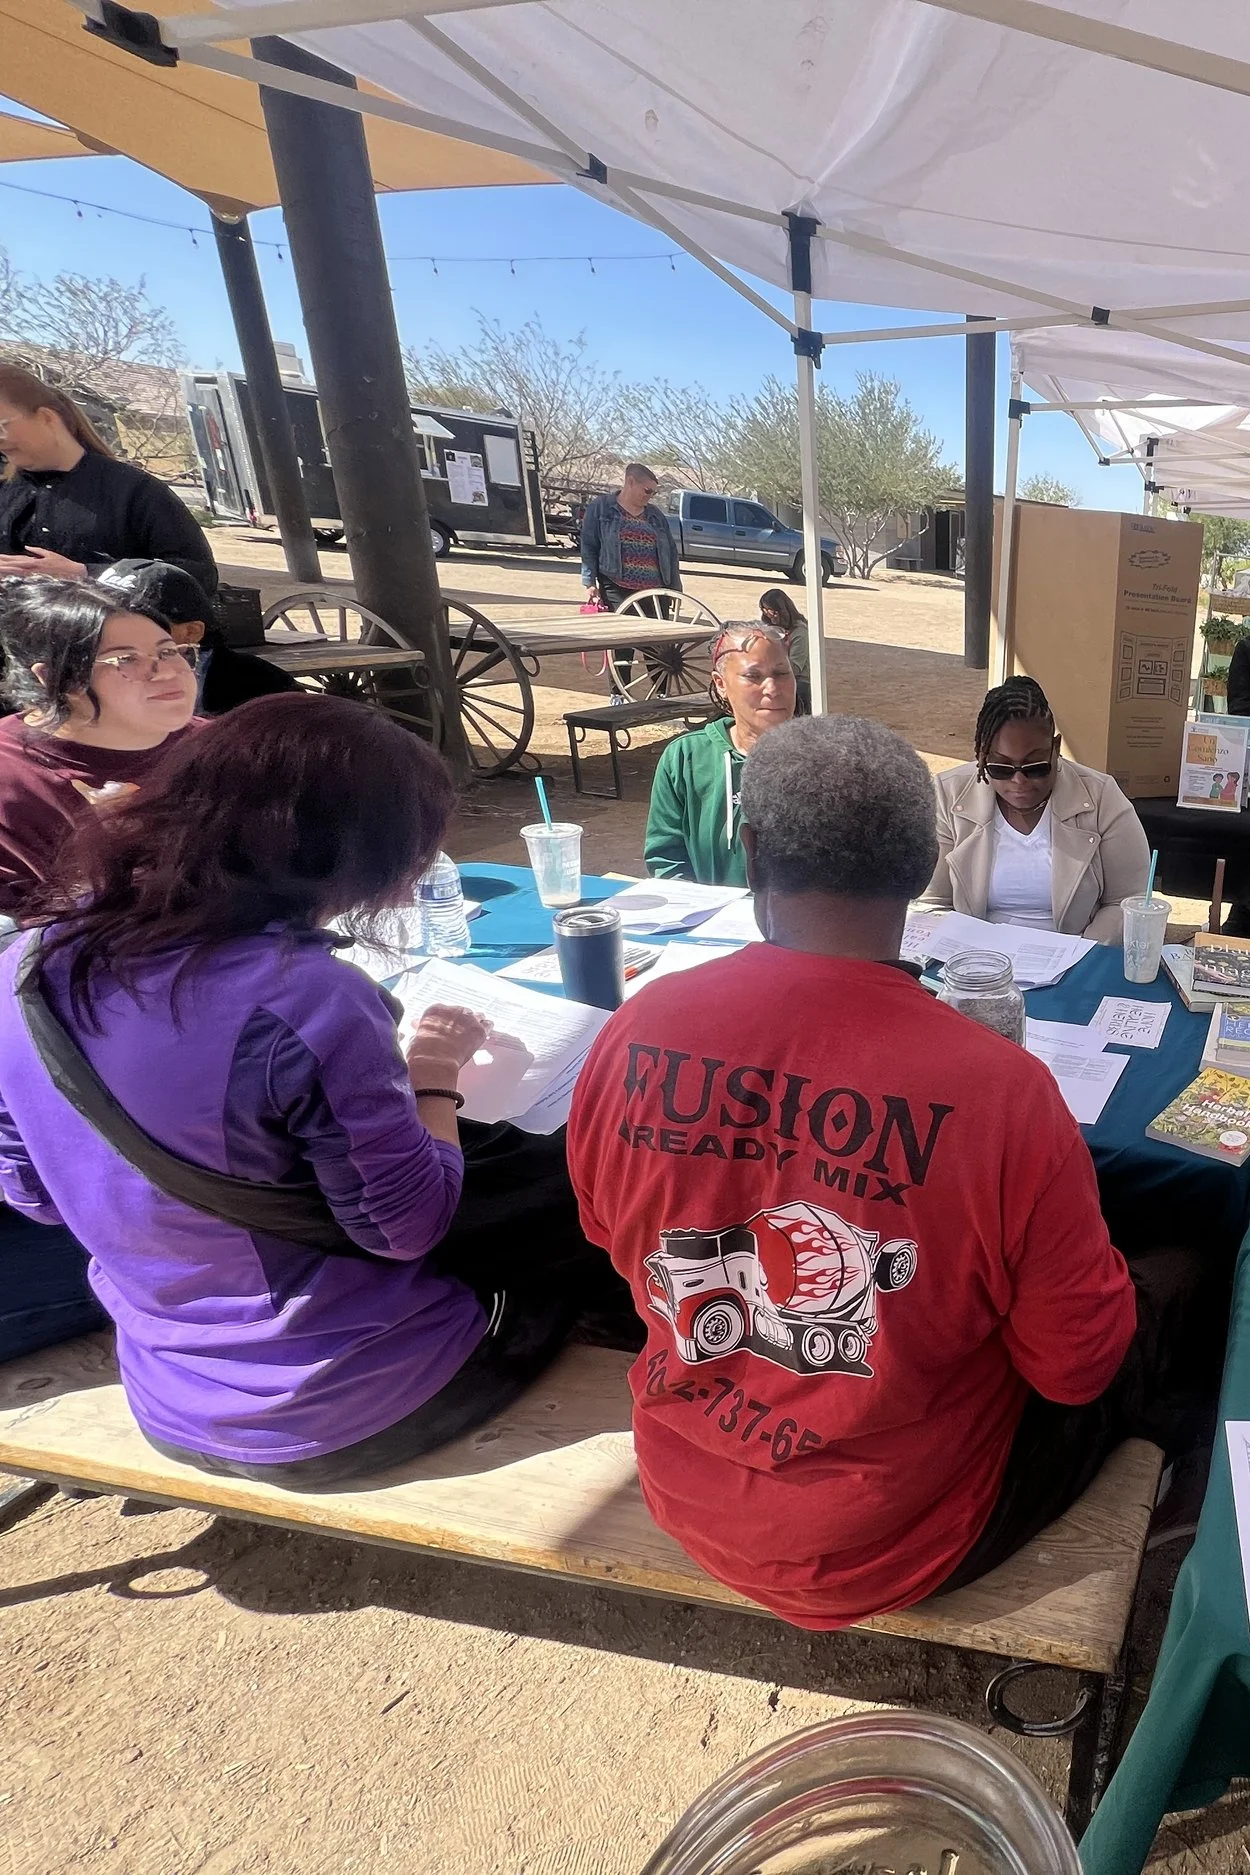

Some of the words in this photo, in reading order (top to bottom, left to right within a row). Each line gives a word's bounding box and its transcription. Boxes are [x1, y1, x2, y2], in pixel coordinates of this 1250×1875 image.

[1123, 589, 1170, 601] Presentation
[1170, 595, 1192, 603] Board
[1152, 583, 1178, 593] Tri-Fold
[618, 1042, 955, 1187] FUSION
[630, 1124, 798, 1172] READY
[813, 1157, 911, 1208] MIX
